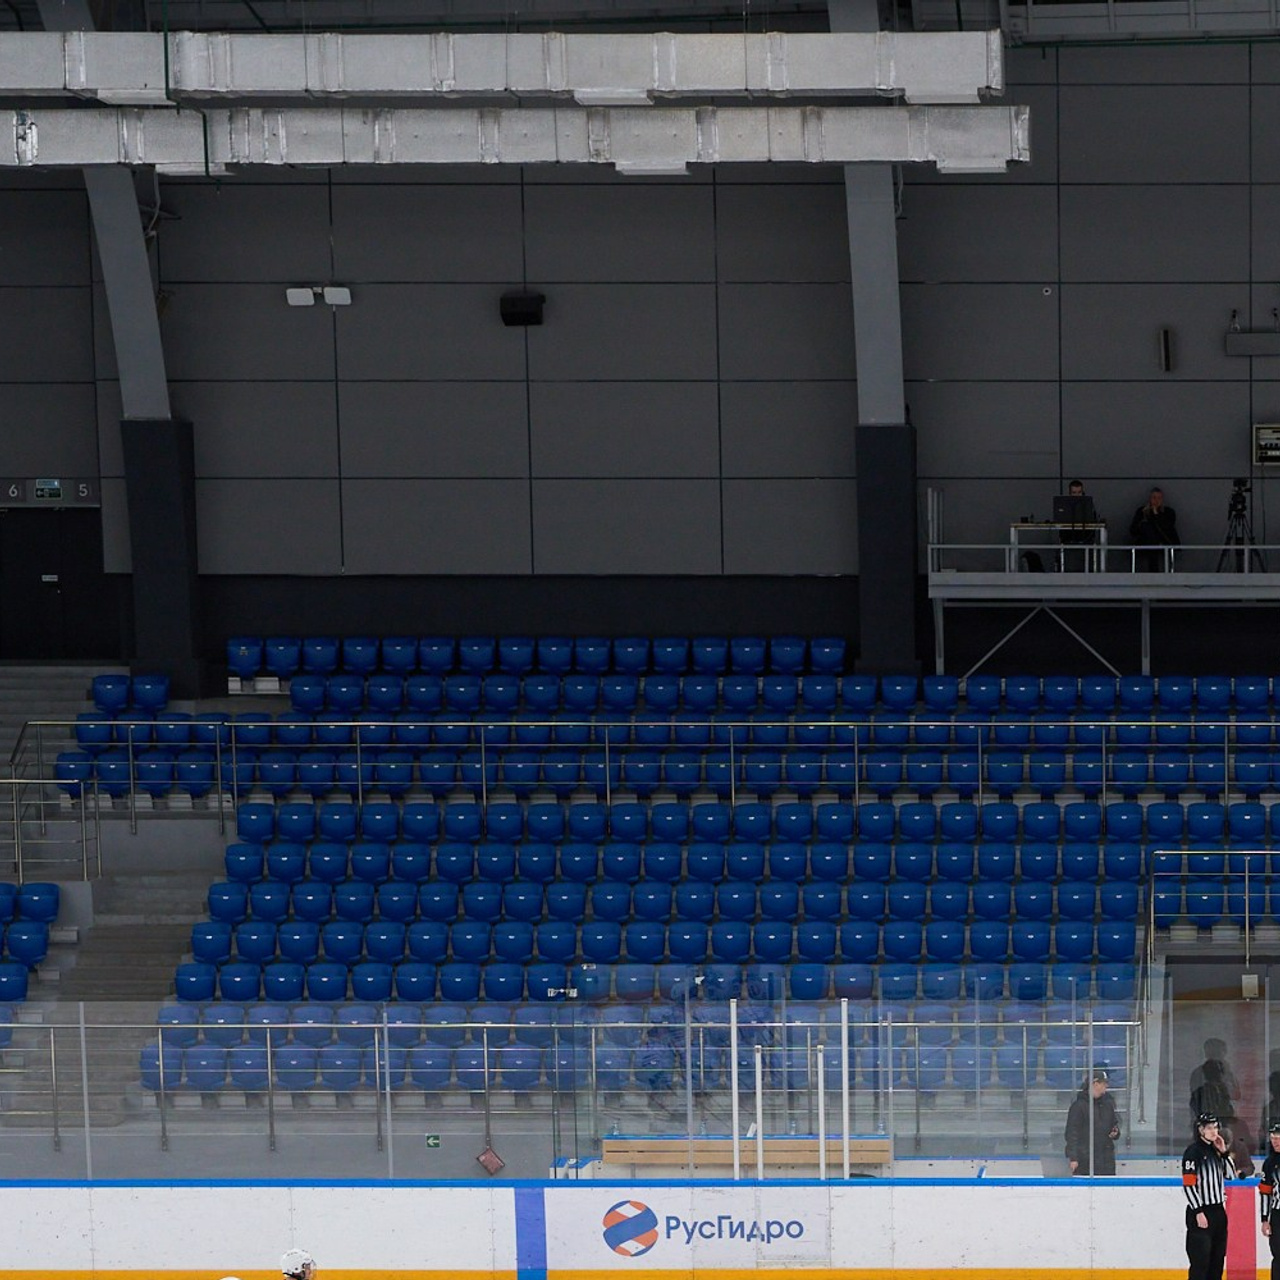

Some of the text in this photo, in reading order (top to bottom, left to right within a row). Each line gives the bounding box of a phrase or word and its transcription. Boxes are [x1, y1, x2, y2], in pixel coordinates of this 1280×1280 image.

[9, 484, 18, 497] 6
[79, 484, 89, 496] 5
[1185, 1160, 1195, 1170] 84
[665, 1215, 804, 1244] РусГидро
